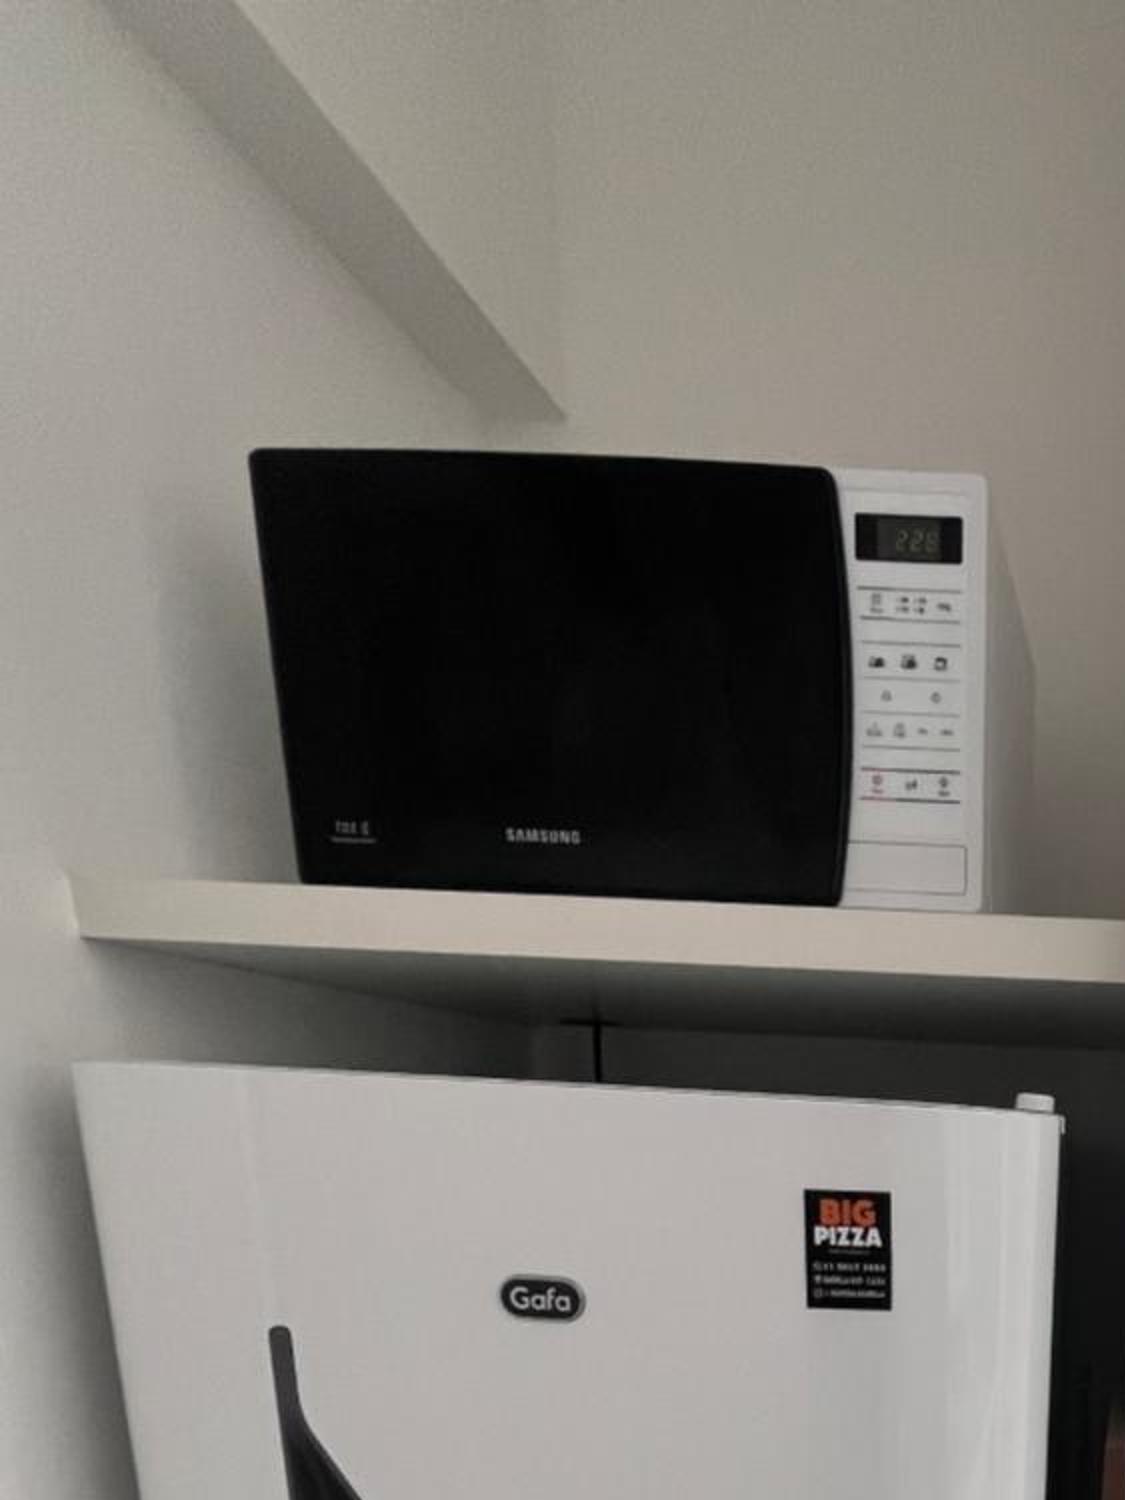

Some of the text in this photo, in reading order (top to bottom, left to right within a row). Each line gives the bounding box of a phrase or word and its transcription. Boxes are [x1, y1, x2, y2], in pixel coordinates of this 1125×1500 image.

[505, 827, 581, 844] SAMSUNG
[820, 1198, 876, 1226] BIG
[813, 1226, 883, 1247] PIZZA
[509, 1286, 571, 1311] Gafa
